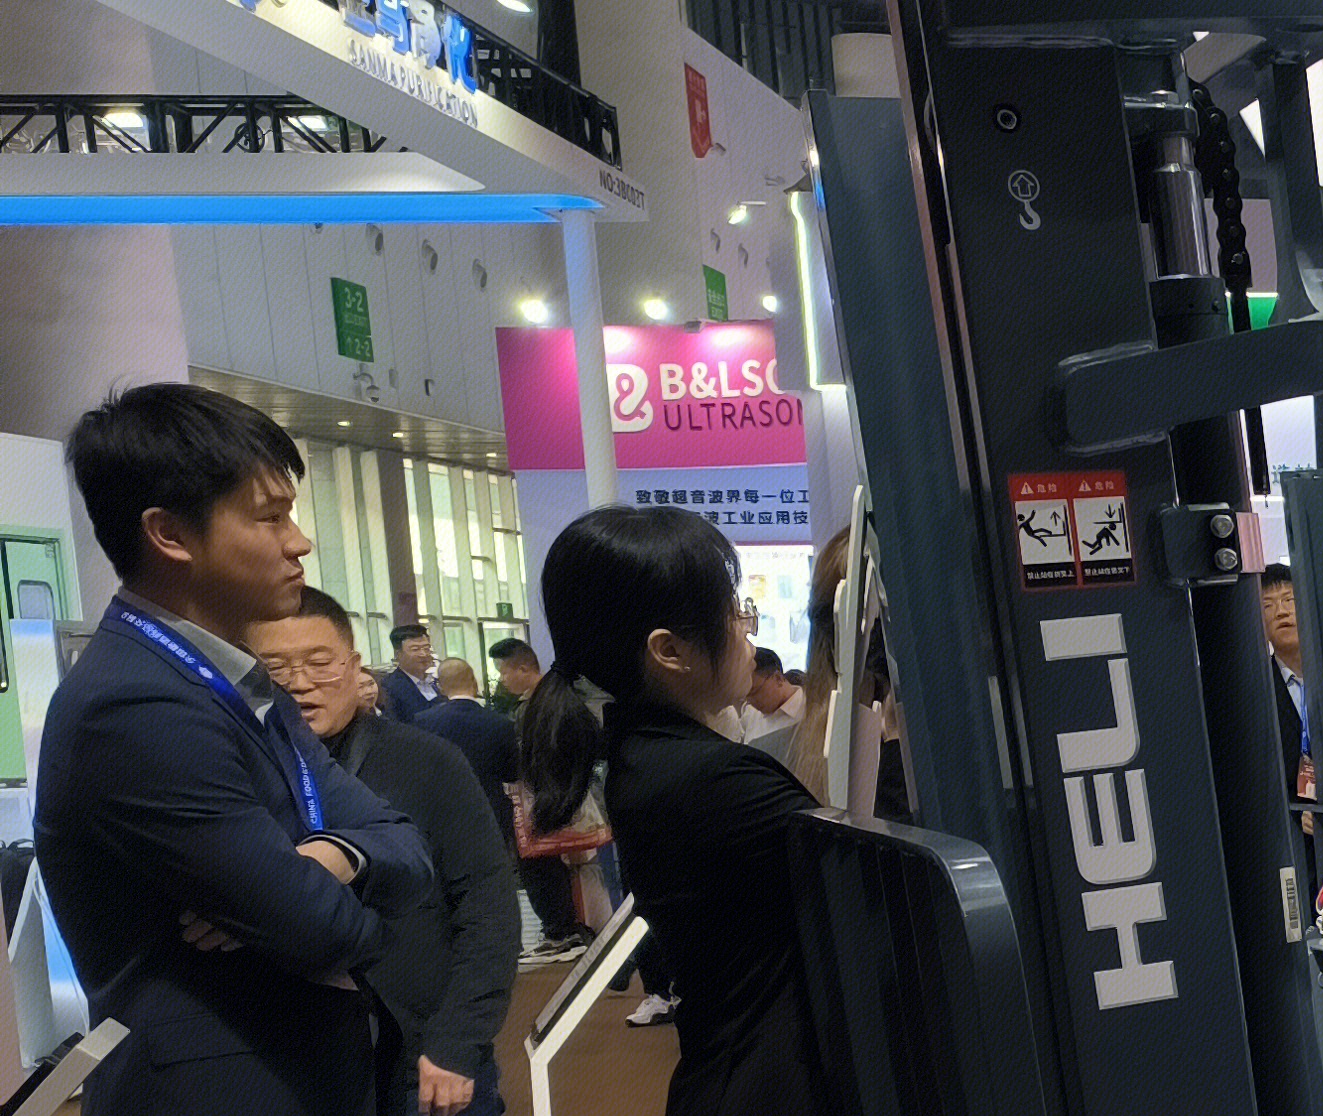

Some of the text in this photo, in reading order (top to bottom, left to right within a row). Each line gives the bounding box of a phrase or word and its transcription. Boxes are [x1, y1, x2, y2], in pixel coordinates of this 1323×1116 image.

[663, 397, 804, 432] ULTRASO
[697, 510, 809, 526] 波工业应用技
[1040, 613, 1179, 1010] HELI
